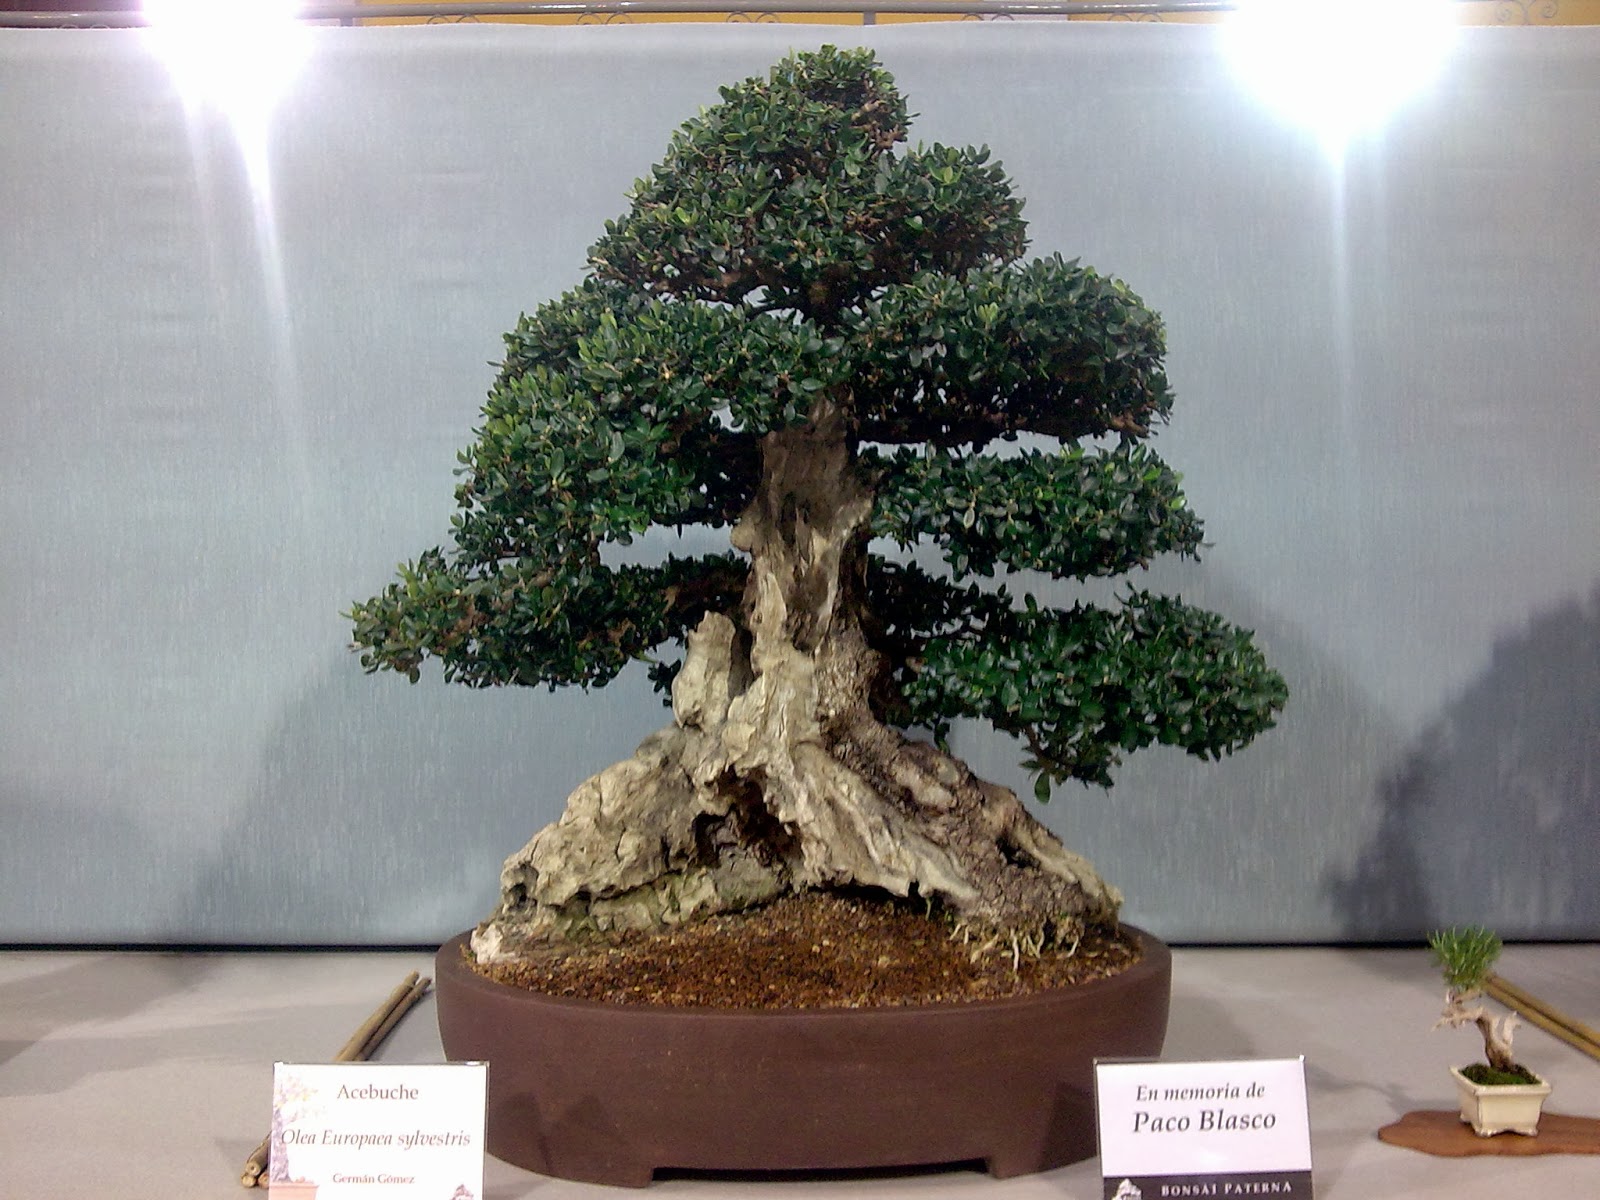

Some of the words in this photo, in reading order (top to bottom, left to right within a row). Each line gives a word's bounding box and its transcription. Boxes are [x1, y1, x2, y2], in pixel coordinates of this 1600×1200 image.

[337, 1084, 419, 1100] Acebuche
[1136, 1086, 1159, 1102] En
[1164, 1082, 1240, 1101] memoria
[1246, 1082, 1266, 1098] de
[1133, 1112, 1191, 1134] Paco
[1199, 1109, 1277, 1132] Blasco
[281, 1129, 316, 1146] Olea
[321, 1130, 393, 1150] Europaea
[397, 1129, 471, 1150] sylvestris
[332, 1173, 375, 1184] Germán
[377, 1173, 415, 1184] Gómez
[1161, 1184, 1218, 1197] BONSAI
[1224, 1181, 1292, 1195] PATERNA
